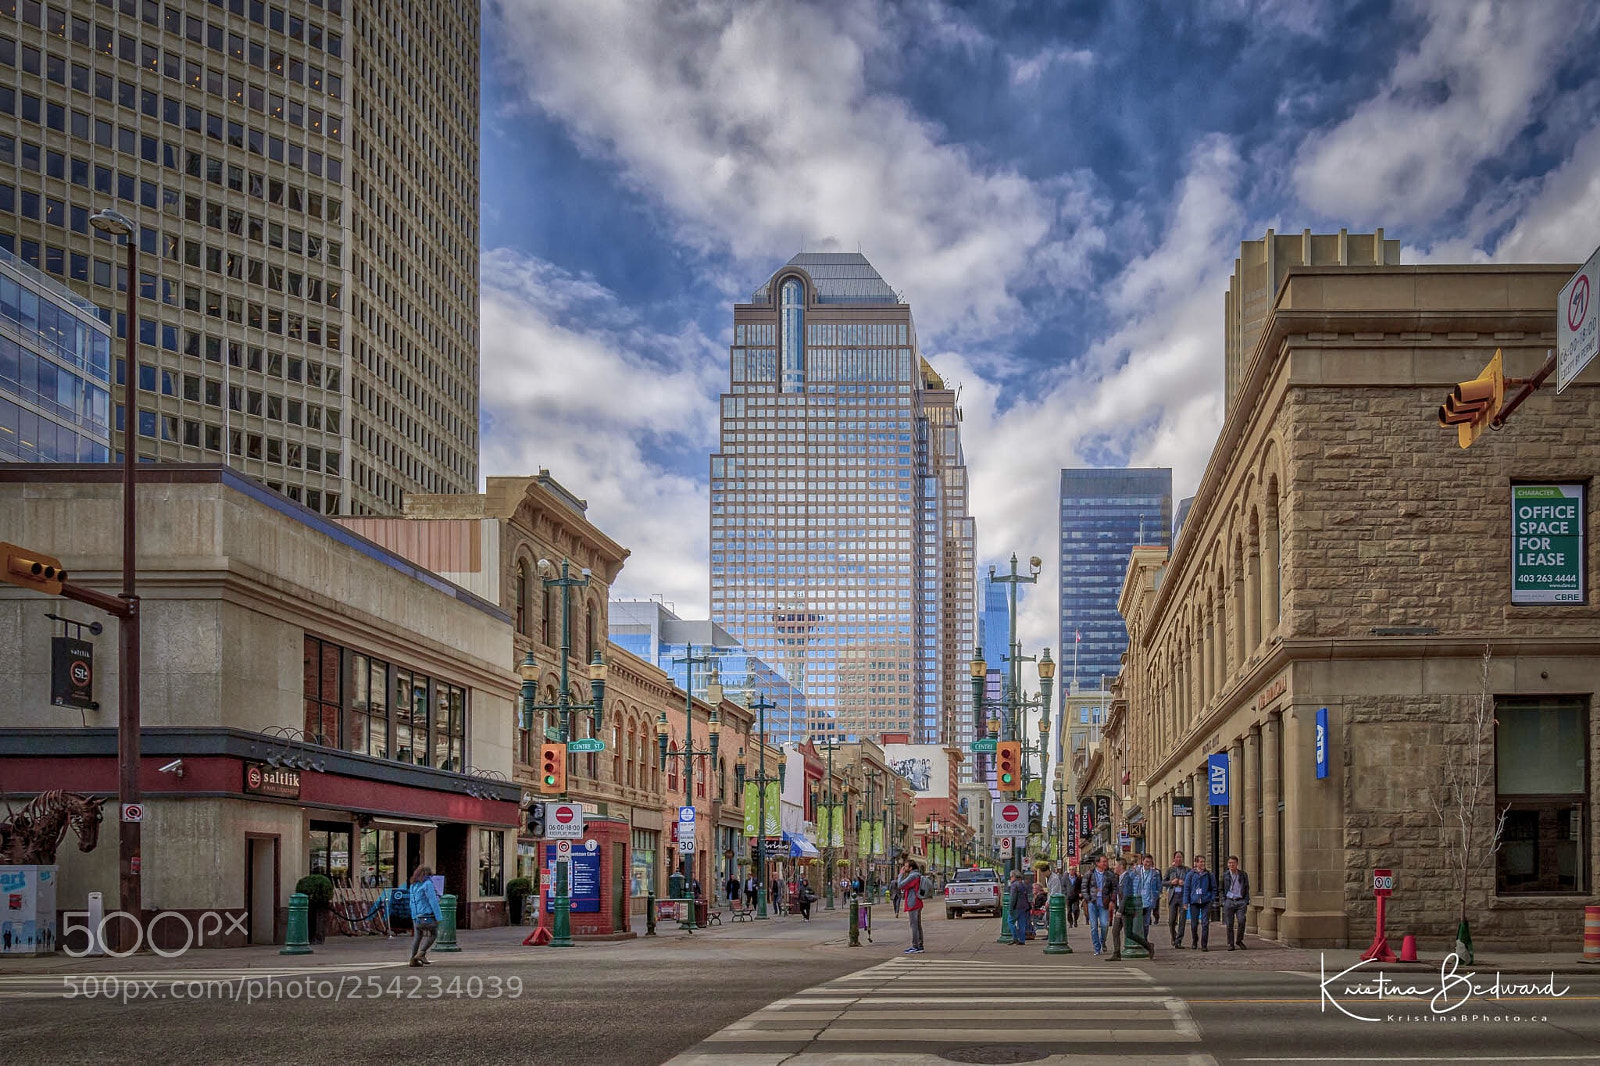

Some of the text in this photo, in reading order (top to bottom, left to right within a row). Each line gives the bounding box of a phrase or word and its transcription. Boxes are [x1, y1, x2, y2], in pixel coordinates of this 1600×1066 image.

[1517, 489, 1555, 497] CHARACTER
[1518, 505, 1576, 520] OFFICE
[1518, 521, 1570, 535] SPACE
[1518, 537, 1552, 551] FOR
[1518, 552, 1566, 567] LEASE
[1518, 574, 1577, 583] 403 263 4444
[1553, 593, 1581, 601] CBRE
[1316, 724, 1325, 765] ATB
[263, 771, 300, 787] saltlik
[1211, 764, 1226, 795] ATB
[1067, 807, 1075, 855] WINNERS
[680, 841, 694, 851] 30
